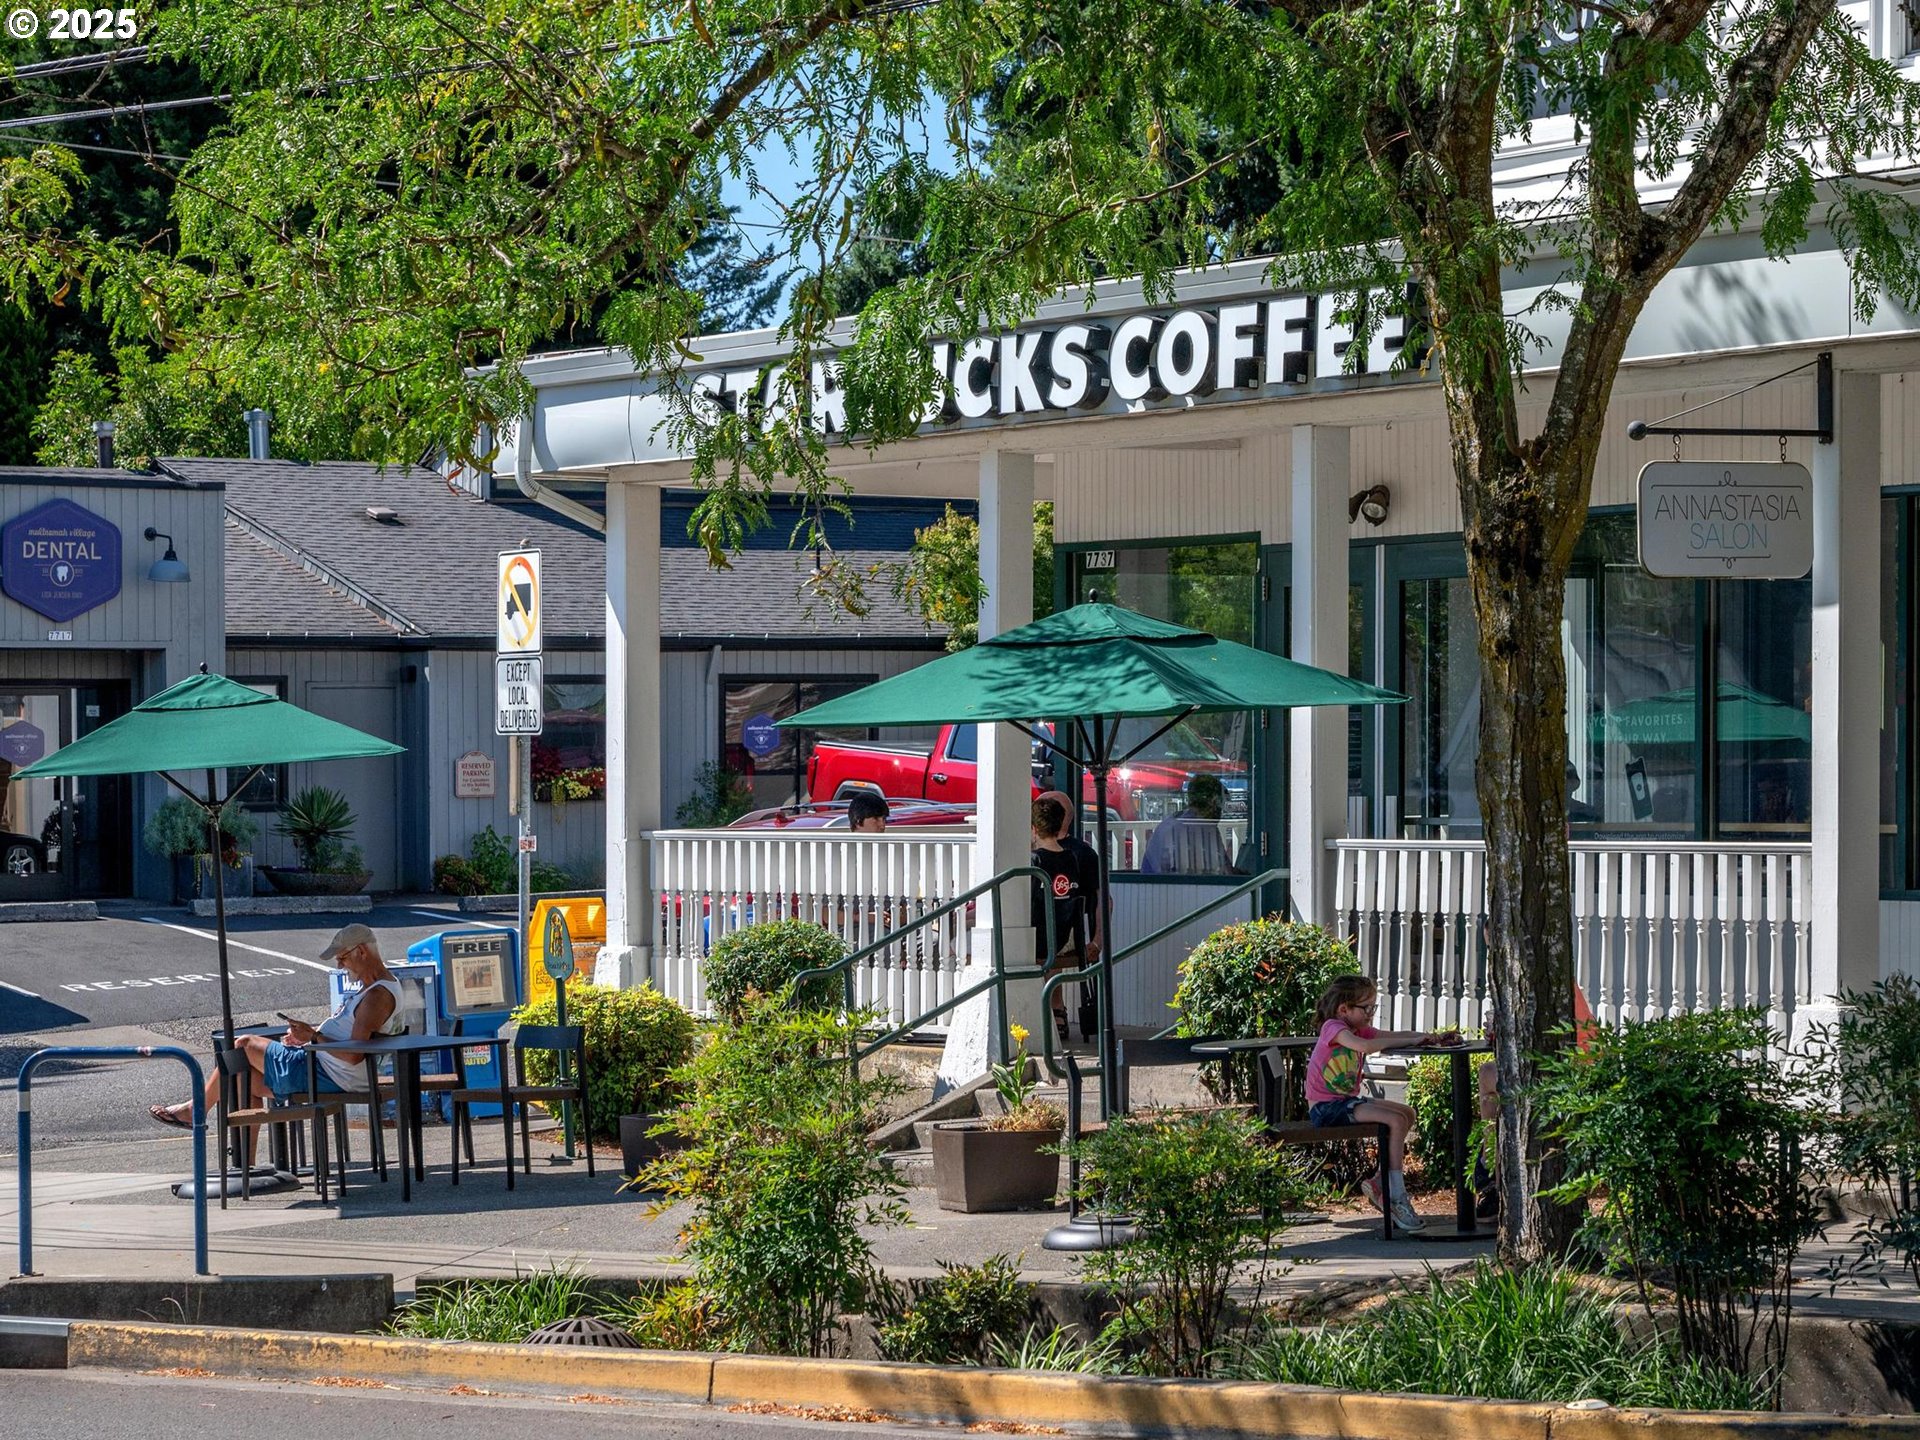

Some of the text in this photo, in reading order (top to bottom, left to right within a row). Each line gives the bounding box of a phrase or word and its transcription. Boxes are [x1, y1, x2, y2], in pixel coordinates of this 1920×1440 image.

[690, 286, 1407, 440] STARUCKS COFFEE
[1655, 494, 1802, 521] ANNASTASIA
[1690, 522, 1768, 549] SALON
[23, 541, 102, 560] DENTAL
[1087, 551, 1114, 567] 7737
[49, 631, 72, 640] 7717
[507, 663, 531, 682] EXCEPT
[508, 686, 529, 705] LOCAL
[500, 709, 537, 728] DELIVERIES
[1625, 714, 1687, 727] FAVORITES.
[1642, 732, 1669, 743] WAY.
[453, 942, 501, 953] FREE
[59, 967, 296, 992] RESERVED
